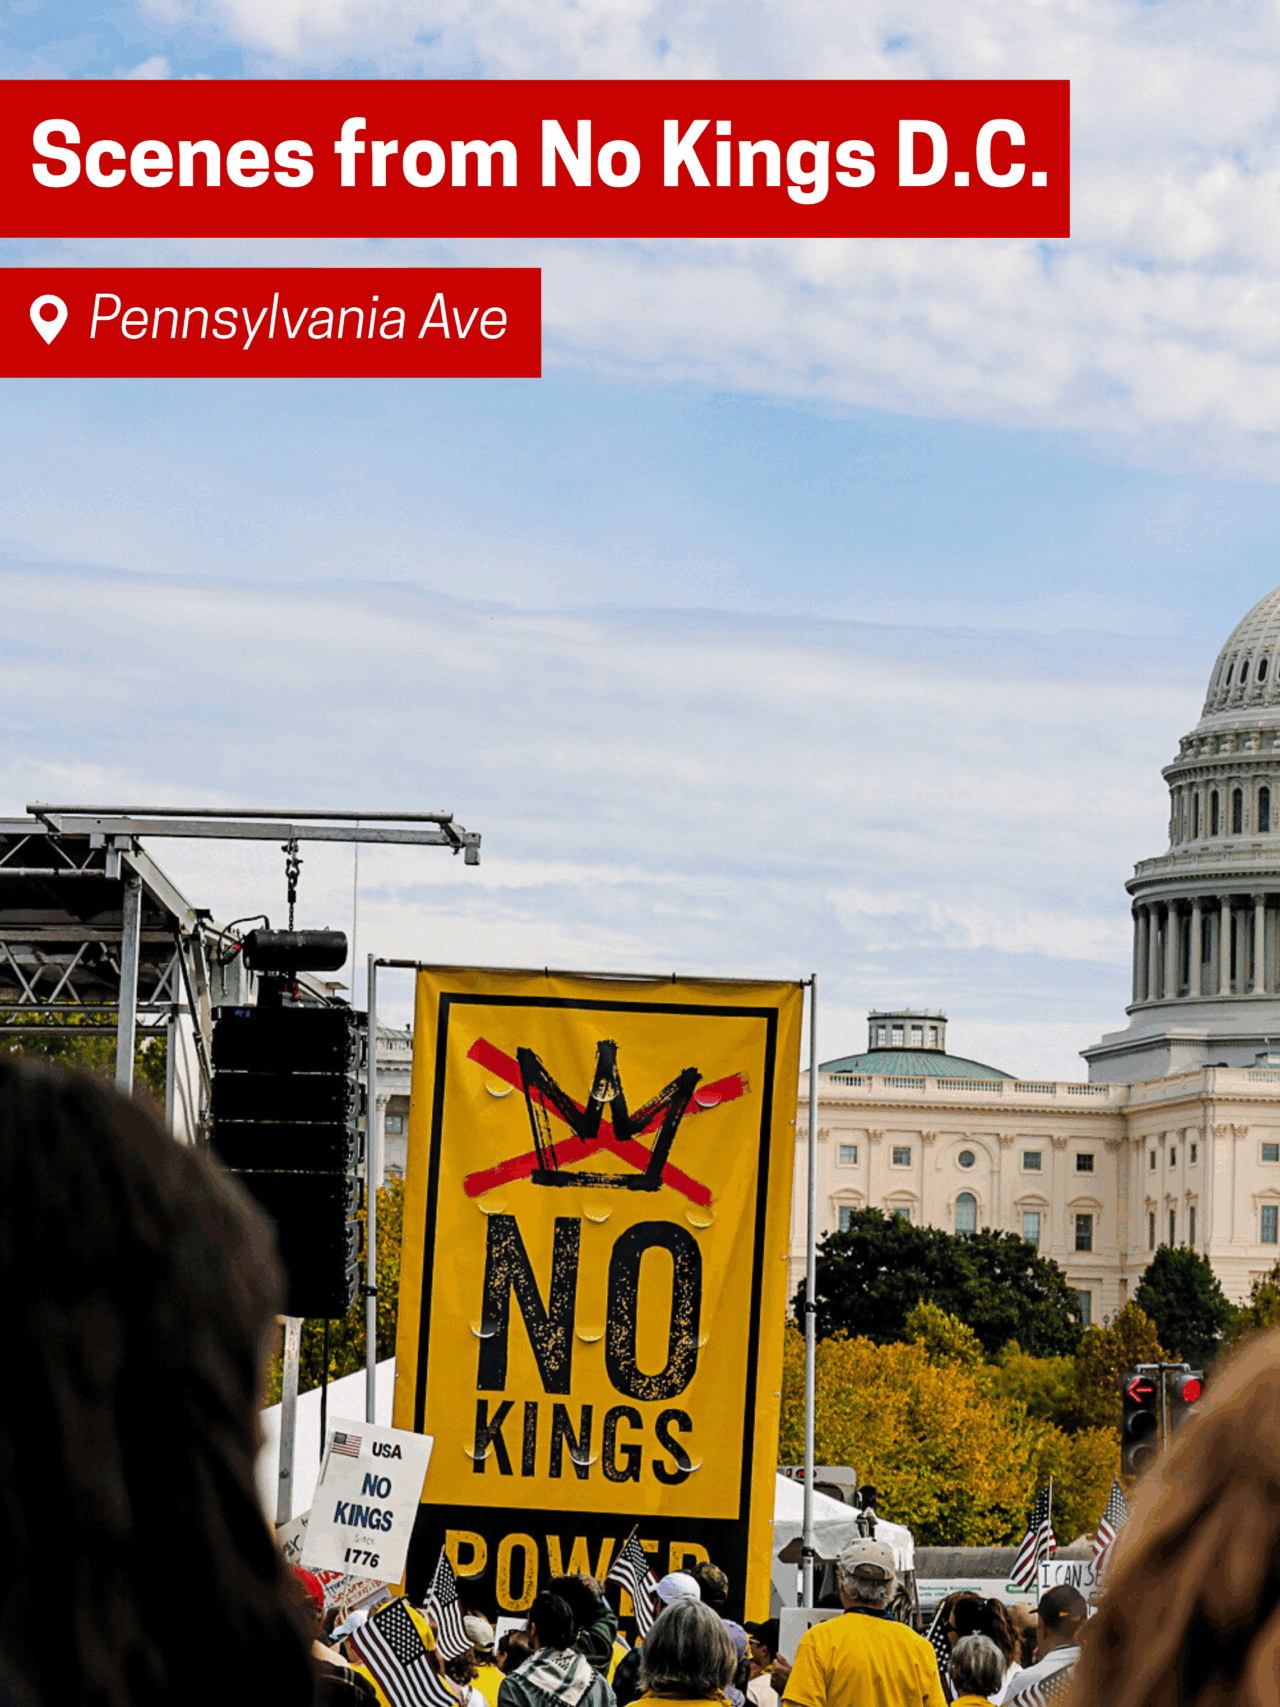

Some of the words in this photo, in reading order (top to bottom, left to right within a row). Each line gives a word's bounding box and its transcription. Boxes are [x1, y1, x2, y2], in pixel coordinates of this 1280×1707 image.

[477, 1213, 703, 1402] NO
[371, 1441, 403, 1460] USA
[472, 1398, 693, 1486] KINGS
[361, 1472, 392, 1499] NO
[333, 1500, 394, 1532] KINGS
[344, 1547, 380, 1568] 1776
[1041, 1564, 1051, 1588] I
[1055, 1564, 1082, 1588] CAN
